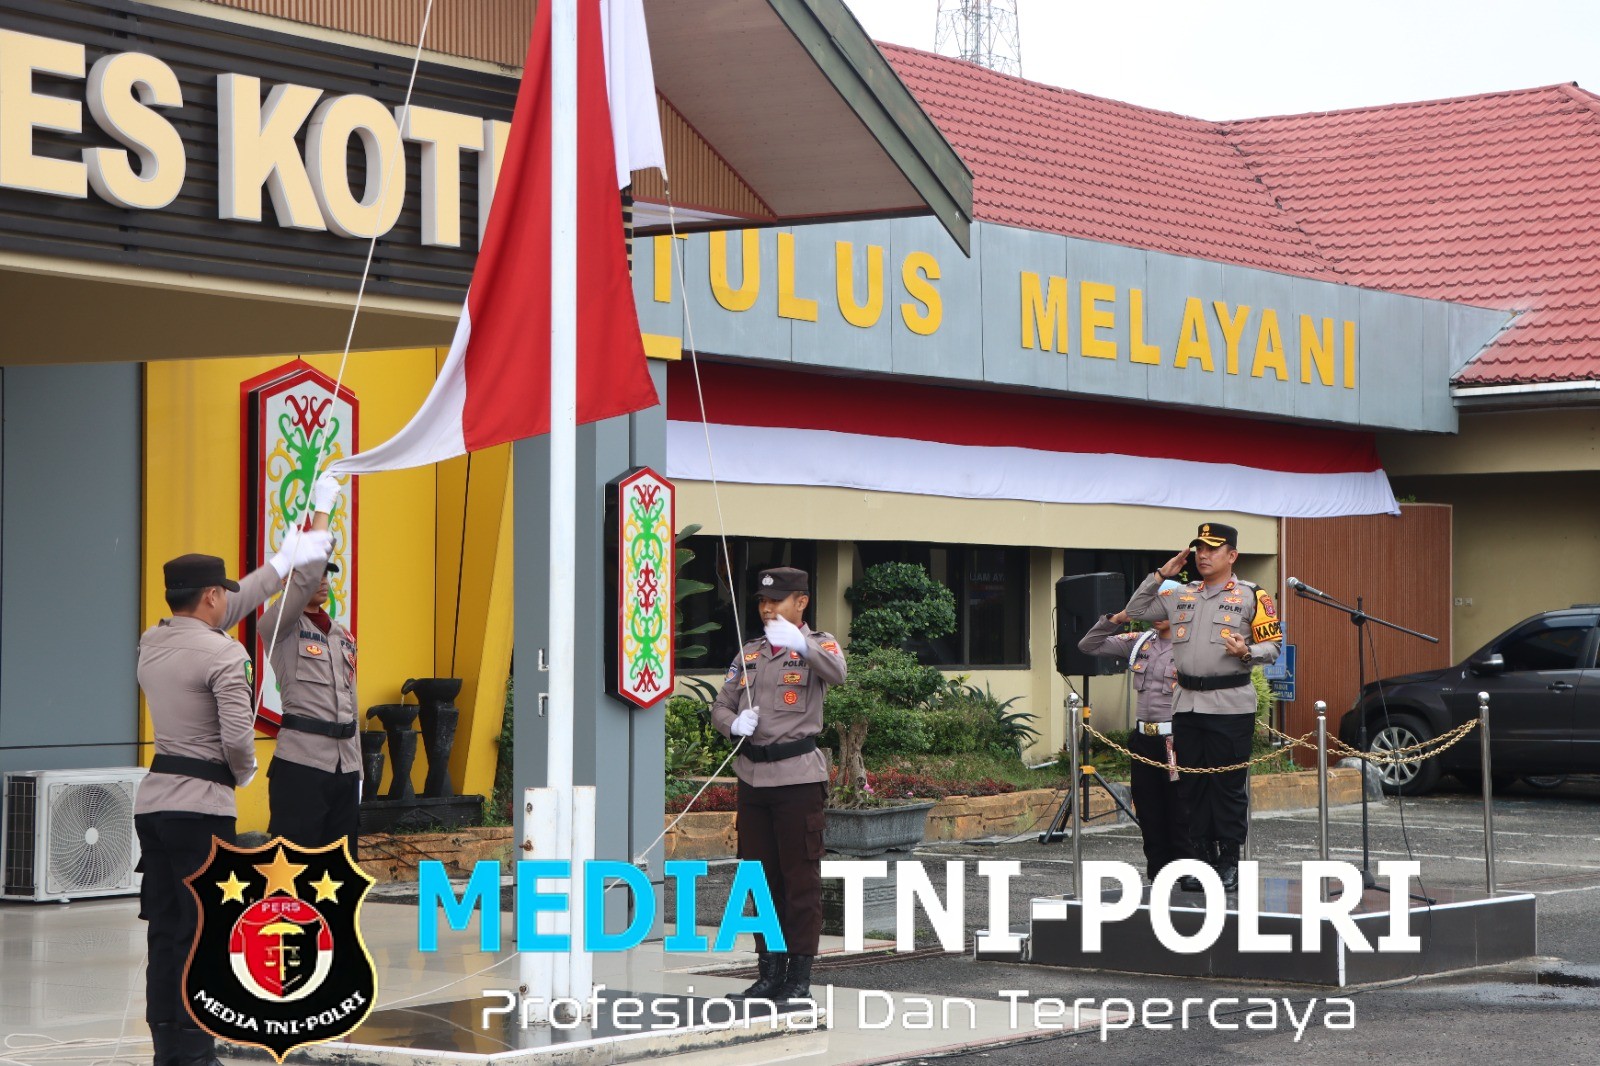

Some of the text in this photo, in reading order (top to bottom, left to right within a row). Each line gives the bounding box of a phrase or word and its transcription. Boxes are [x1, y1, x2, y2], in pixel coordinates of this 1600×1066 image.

[653, 227, 1356, 389] TULUS MELAYANI
[1218, 604, 1242, 613] POLRI
[783, 660, 807, 668] POLRI
